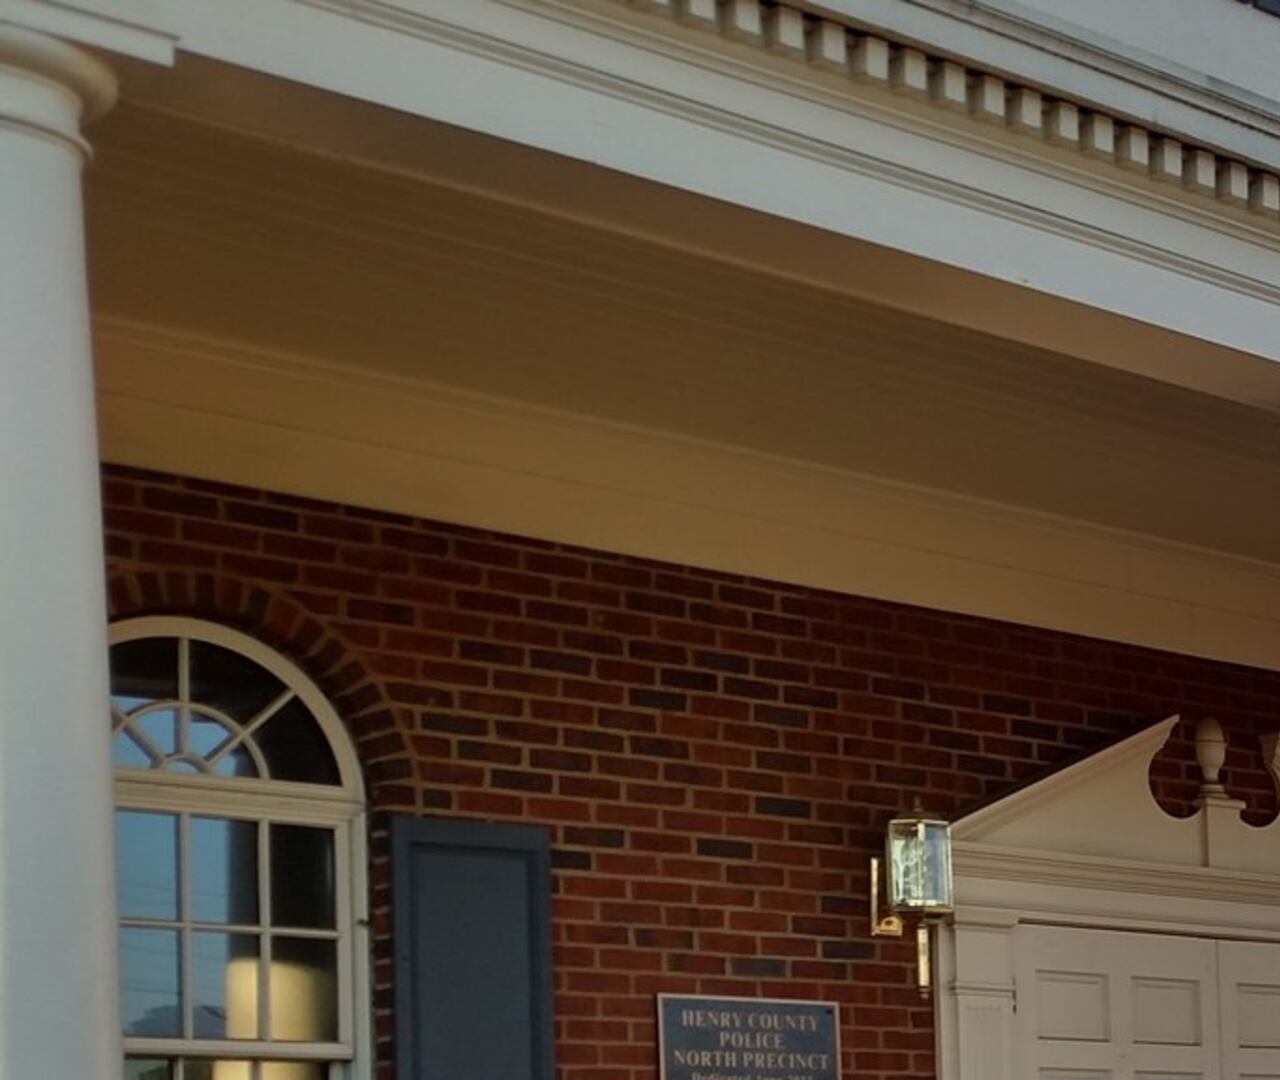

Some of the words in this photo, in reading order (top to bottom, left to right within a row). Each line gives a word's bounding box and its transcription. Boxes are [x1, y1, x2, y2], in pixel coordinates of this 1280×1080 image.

[681, 1009, 741, 1028] HENRY
[748, 1013, 818, 1031] COUNTY
[719, 1032, 786, 1049] POLICE
[674, 1050, 737, 1068] NORTH
[743, 1052, 829, 1070] PRECINCT
